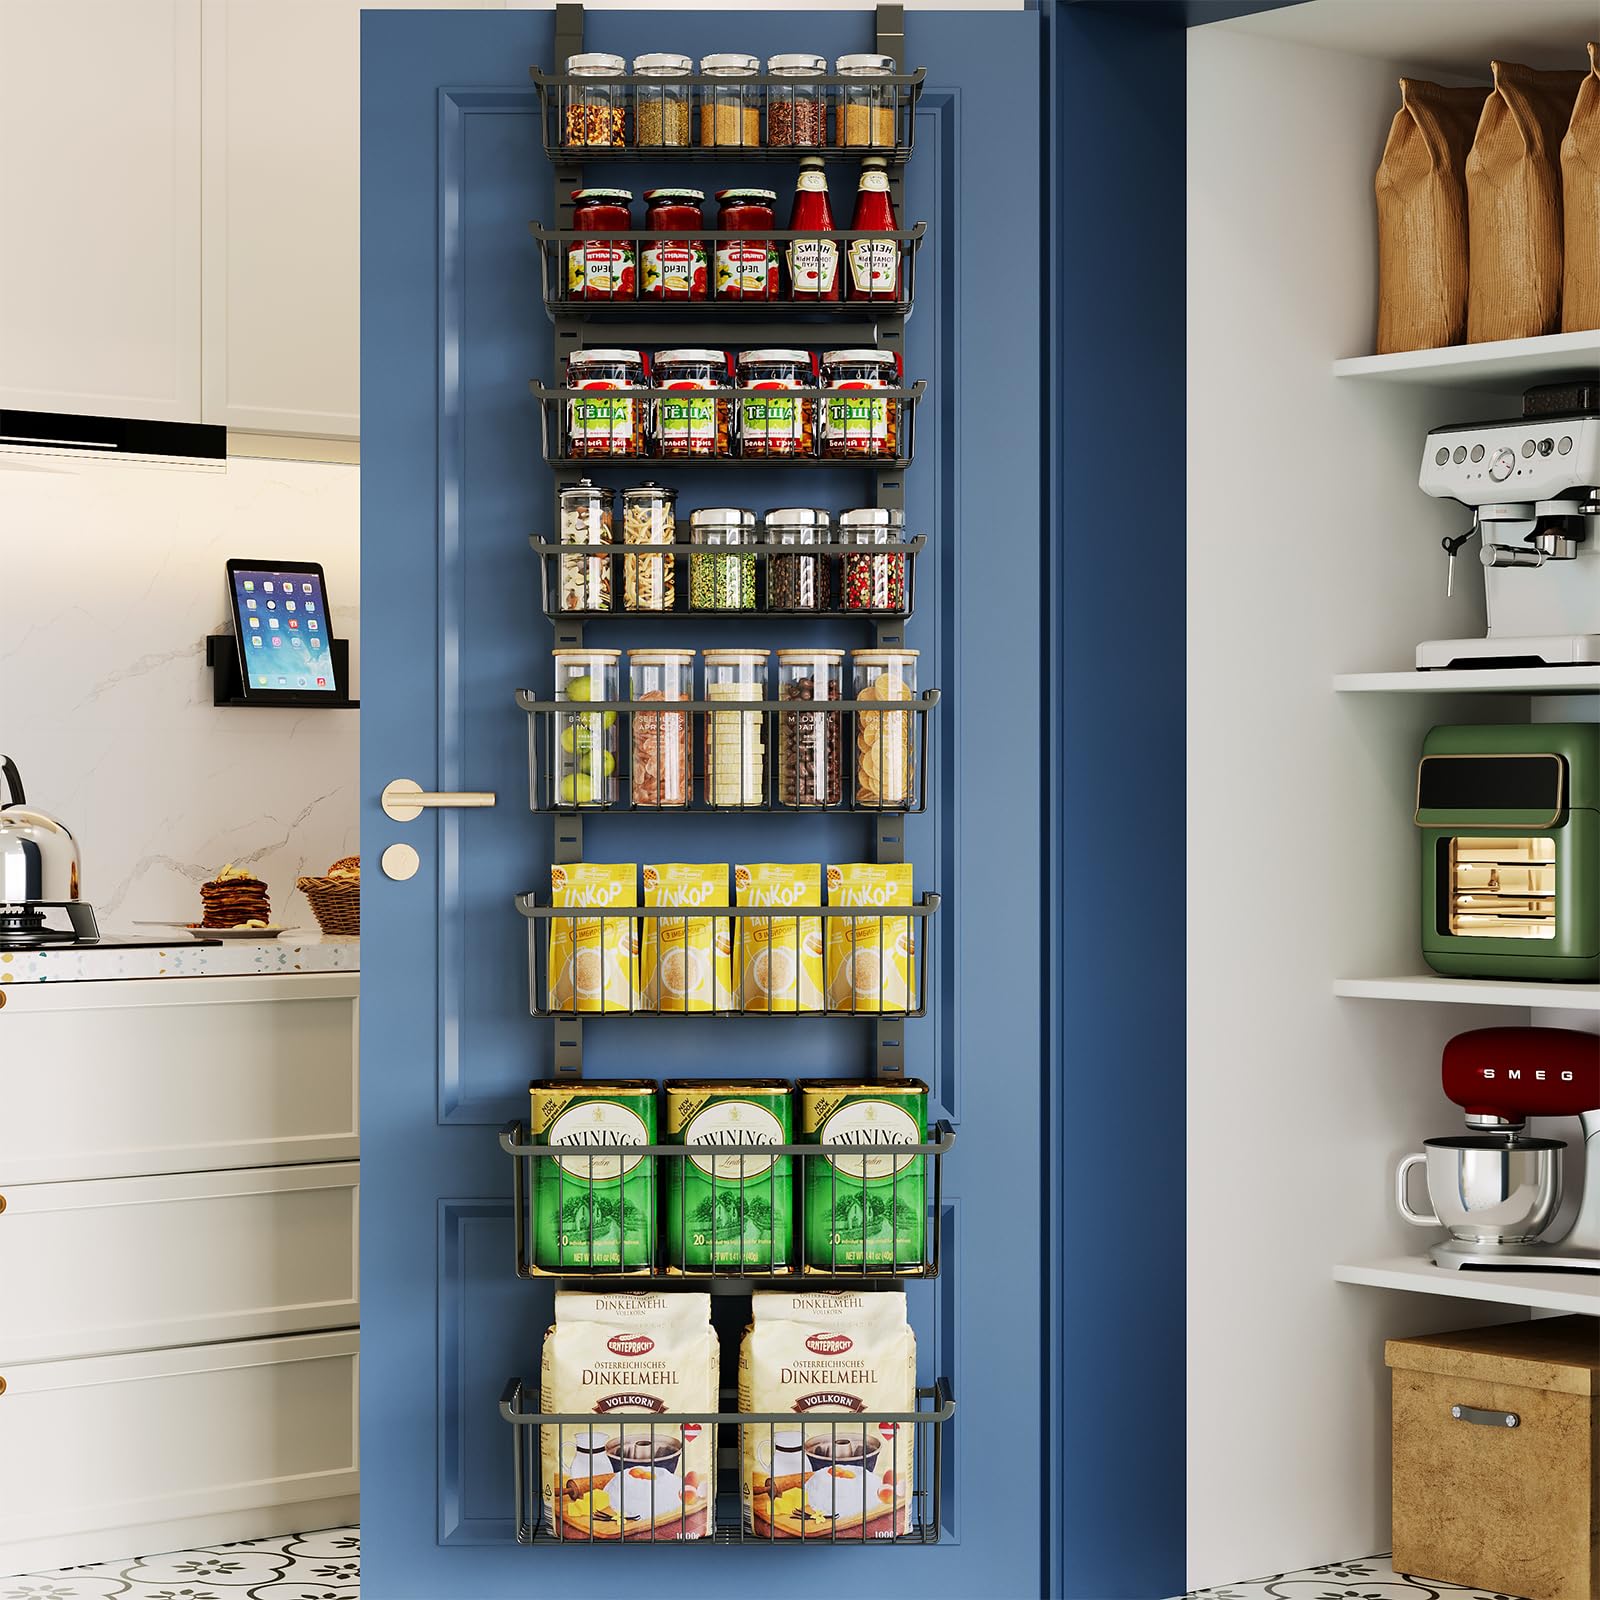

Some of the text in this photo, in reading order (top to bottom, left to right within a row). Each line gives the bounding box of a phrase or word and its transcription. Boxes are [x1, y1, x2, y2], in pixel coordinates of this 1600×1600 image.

[1483, 1069, 1573, 1081] SMEG
[542, 1098, 553, 1112] NEW
[678, 1098, 690, 1111] NEW
[681, 1103, 693, 1116] LOOK
[814, 1097, 825, 1110] NEW
[817, 1103, 830, 1116] LOOK
[545, 1103, 557, 1117] LOOK
[693, 1234, 705, 1245] 20
[596, 1299, 668, 1310] DINKELMEHL
[793, 1298, 864, 1309] DINKELMEHL
[608, 1341, 653, 1353] ERNTEPRACHT
[807, 1340, 851, 1352] ERNTEPRACHT
[594, 1360, 666, 1369] ÖSTERREICHISCHES
[793, 1359, 864, 1368] ÖSTERREICHISCHES
[582, 1369, 679, 1385] DINKELMEHL
[781, 1368, 878, 1384] DINKELMEHL
[606, 1396, 654, 1408] VOLLKORN
[805, 1395, 853, 1406] VOLLKORN
